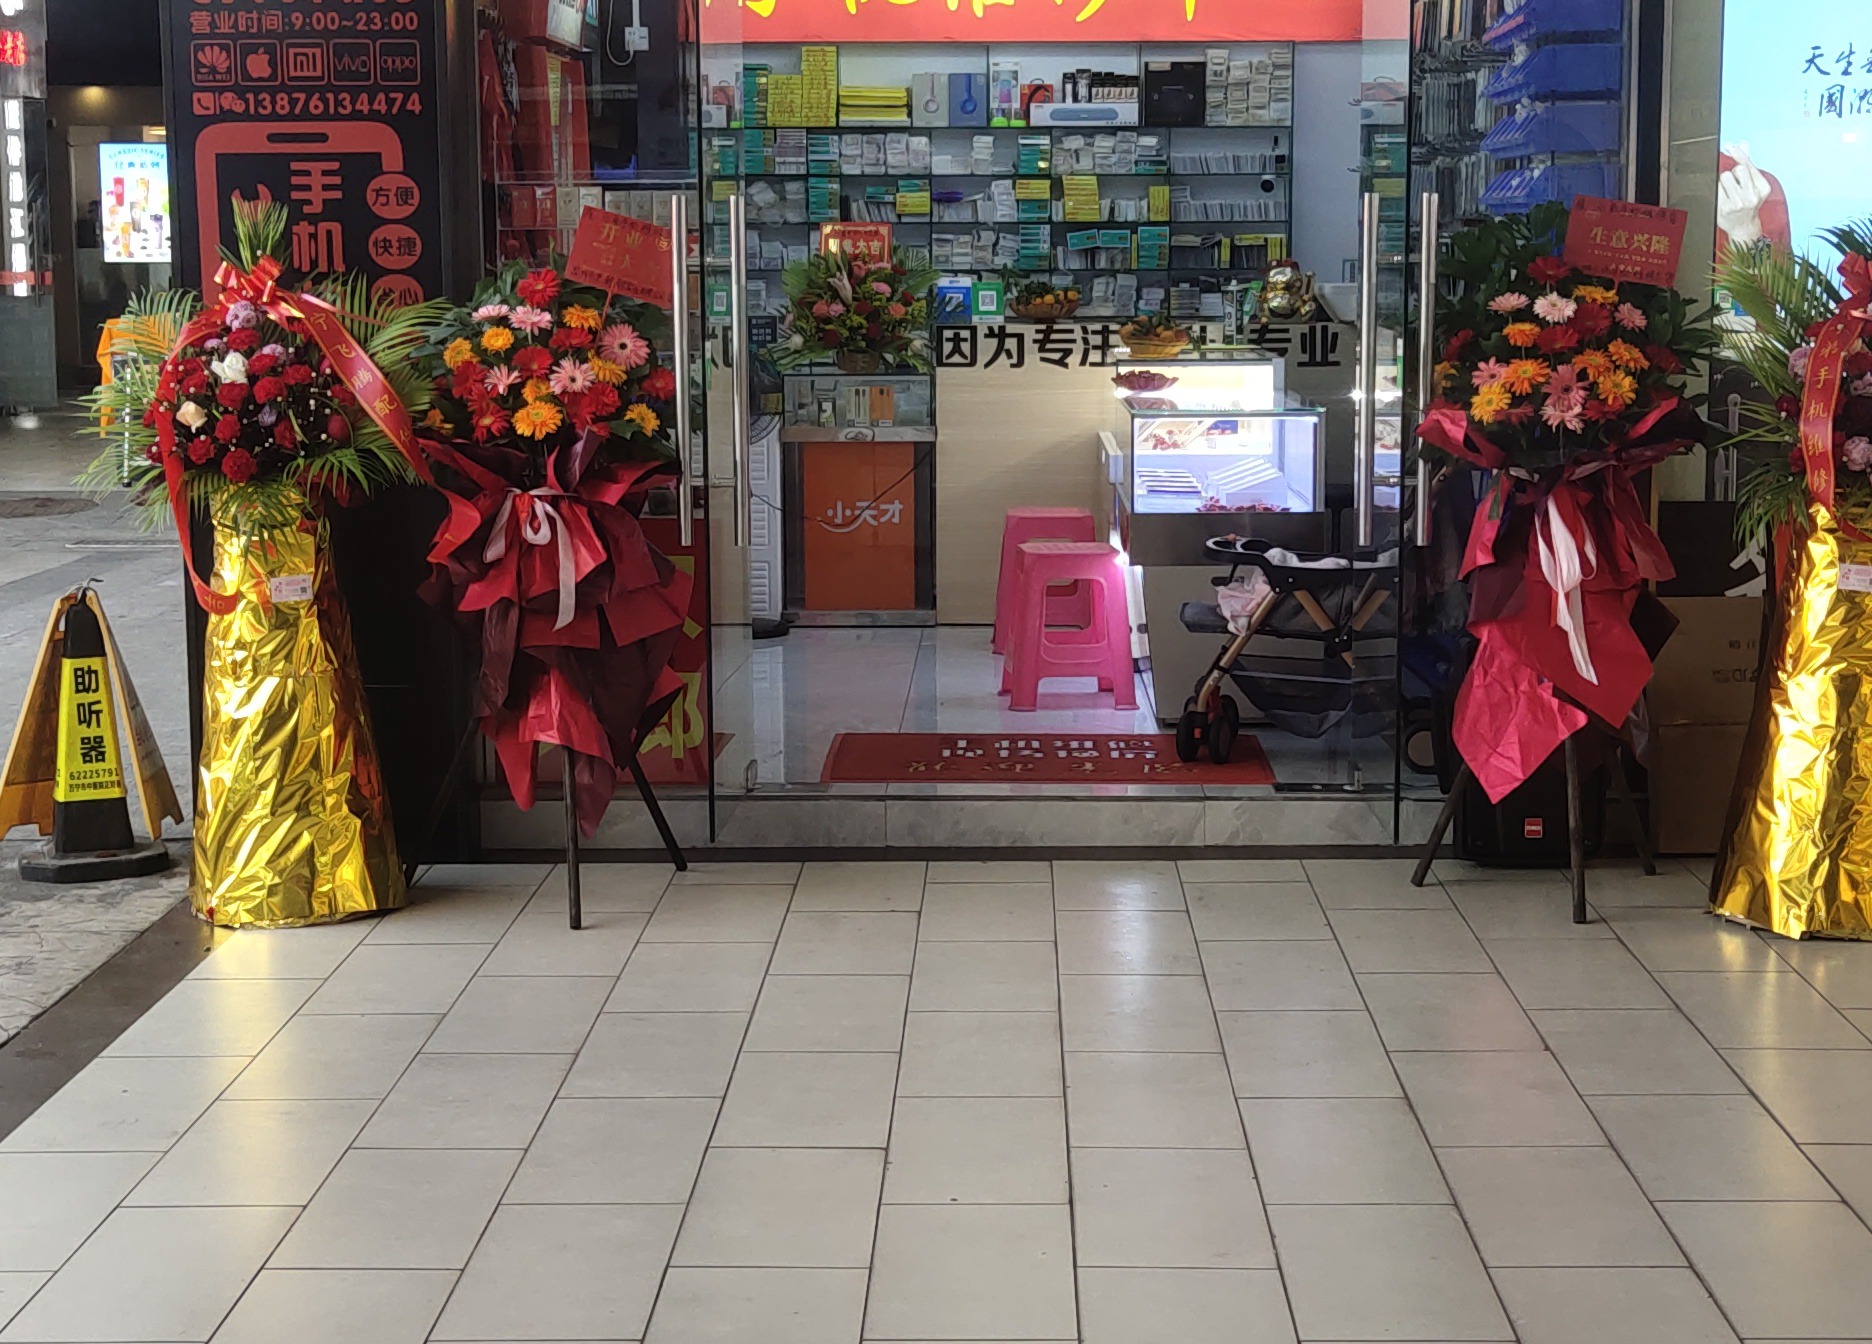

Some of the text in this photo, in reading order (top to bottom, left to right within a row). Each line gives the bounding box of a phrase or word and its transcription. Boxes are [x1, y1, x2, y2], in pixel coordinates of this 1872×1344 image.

[246, 92, 422, 115] 13876134474
[371, 186, 415, 207] 方便
[373, 236, 417, 257] 快捷
[1590, 226, 1670, 255] 生意兴隆
[826, 499, 904, 528] 小天才
[73, 665, 107, 764] 助听器
[69, 768, 119, 781] 62225791
